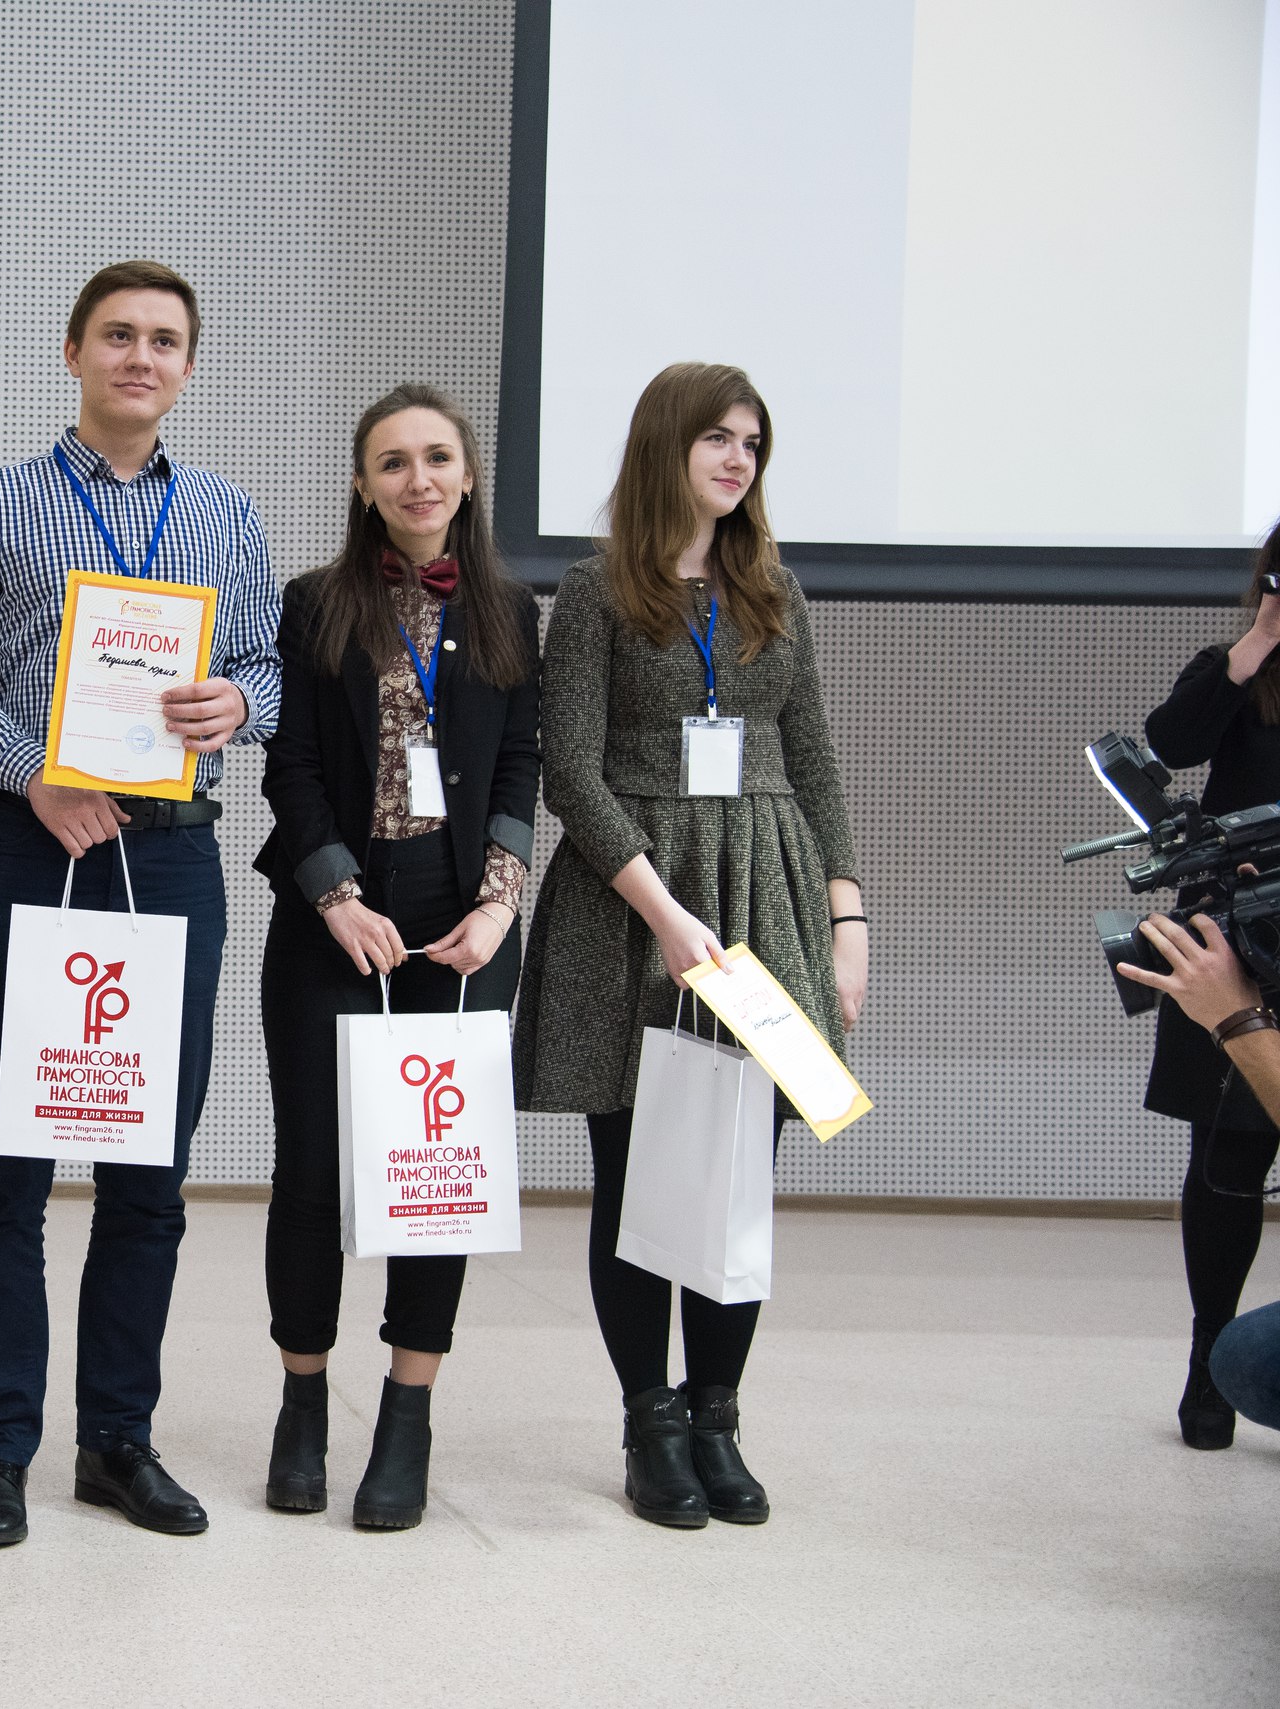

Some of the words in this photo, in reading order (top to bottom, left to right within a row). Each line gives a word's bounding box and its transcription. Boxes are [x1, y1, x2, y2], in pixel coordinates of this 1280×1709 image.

[92, 627, 180, 655] ДИПЛОМ
[40, 1047, 141, 1069] ФИНАНСОВАЯ
[36, 1066, 146, 1088] ГРАМОТНОСТЬ
[50, 1086, 129, 1106] НАСЕЛЕНИЯ
[39, 1108, 78, 1118] ЗНАНИЯ
[81, 1110, 101, 1120] ДЛЯ
[105, 1110, 141, 1121] ЖИЗНИ
[55, 1124, 124, 1136] www.fingram26.ru
[53, 1134, 125, 1145] www.finedu-skfo.ru
[388, 1146, 481, 1165] ФИНАНСОВАЯ
[387, 1164, 488, 1183] ГРАМОТНОСТЬ
[401, 1182, 473, 1200] НАСЕЛЕНИЯ
[392, 1205, 428, 1215] ЗНАНИЯ
[432, 1205, 449, 1215] ДЛЯ
[453, 1203, 485, 1213] ЖИЗНИ
[407, 1219, 470, 1229] www.fingram26.ru
[407, 1228, 472, 1238] www.finedu-skfo.ru
